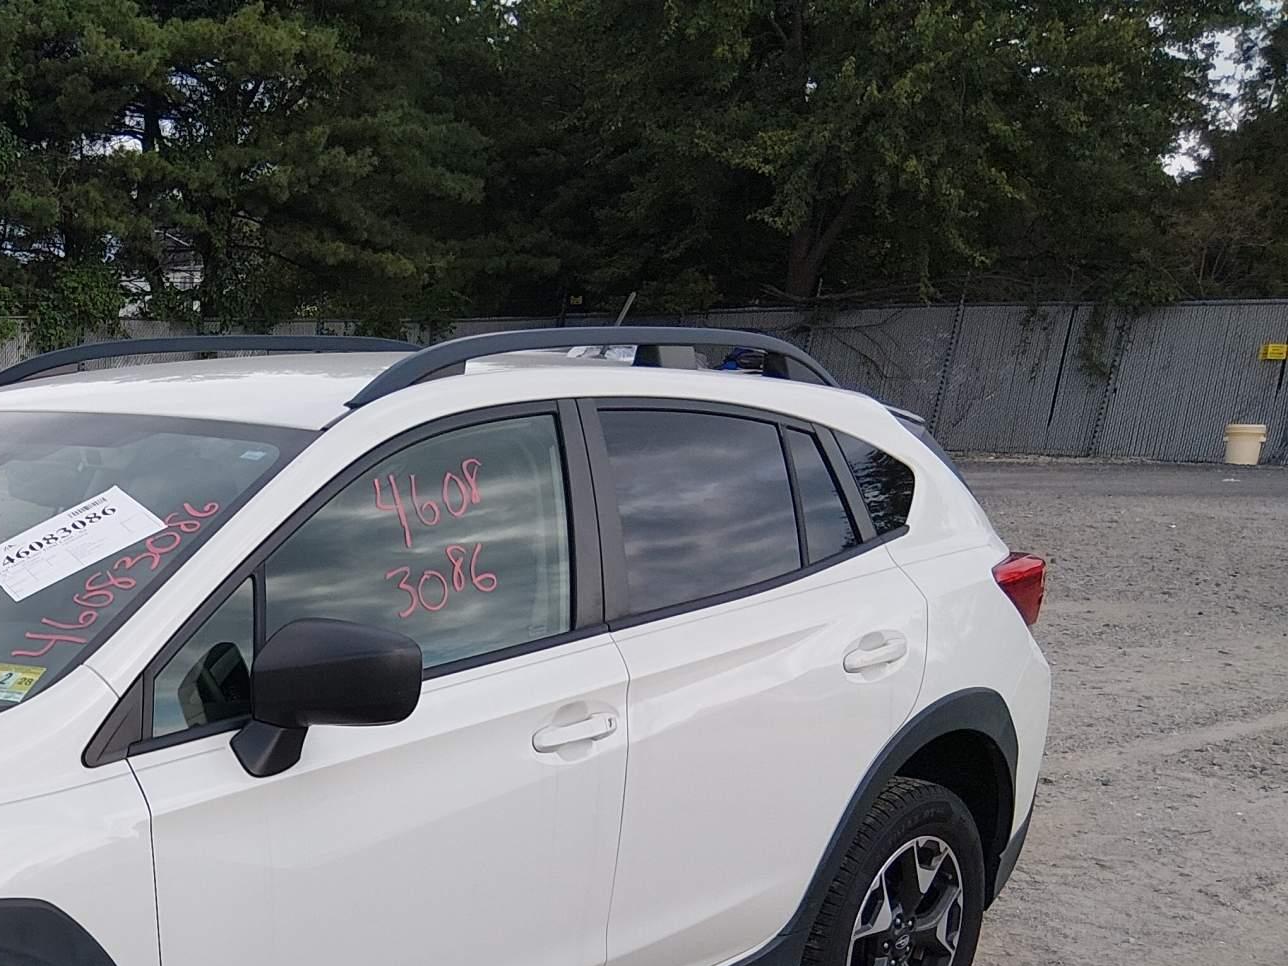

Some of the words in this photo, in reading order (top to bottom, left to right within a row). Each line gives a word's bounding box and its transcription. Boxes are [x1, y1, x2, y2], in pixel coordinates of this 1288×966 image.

[2, 505, 117, 567] 46083086
[373, 458, 482, 548] 4608
[11, 501, 219, 657] 46083086
[385, 543, 497, 618] 3086
